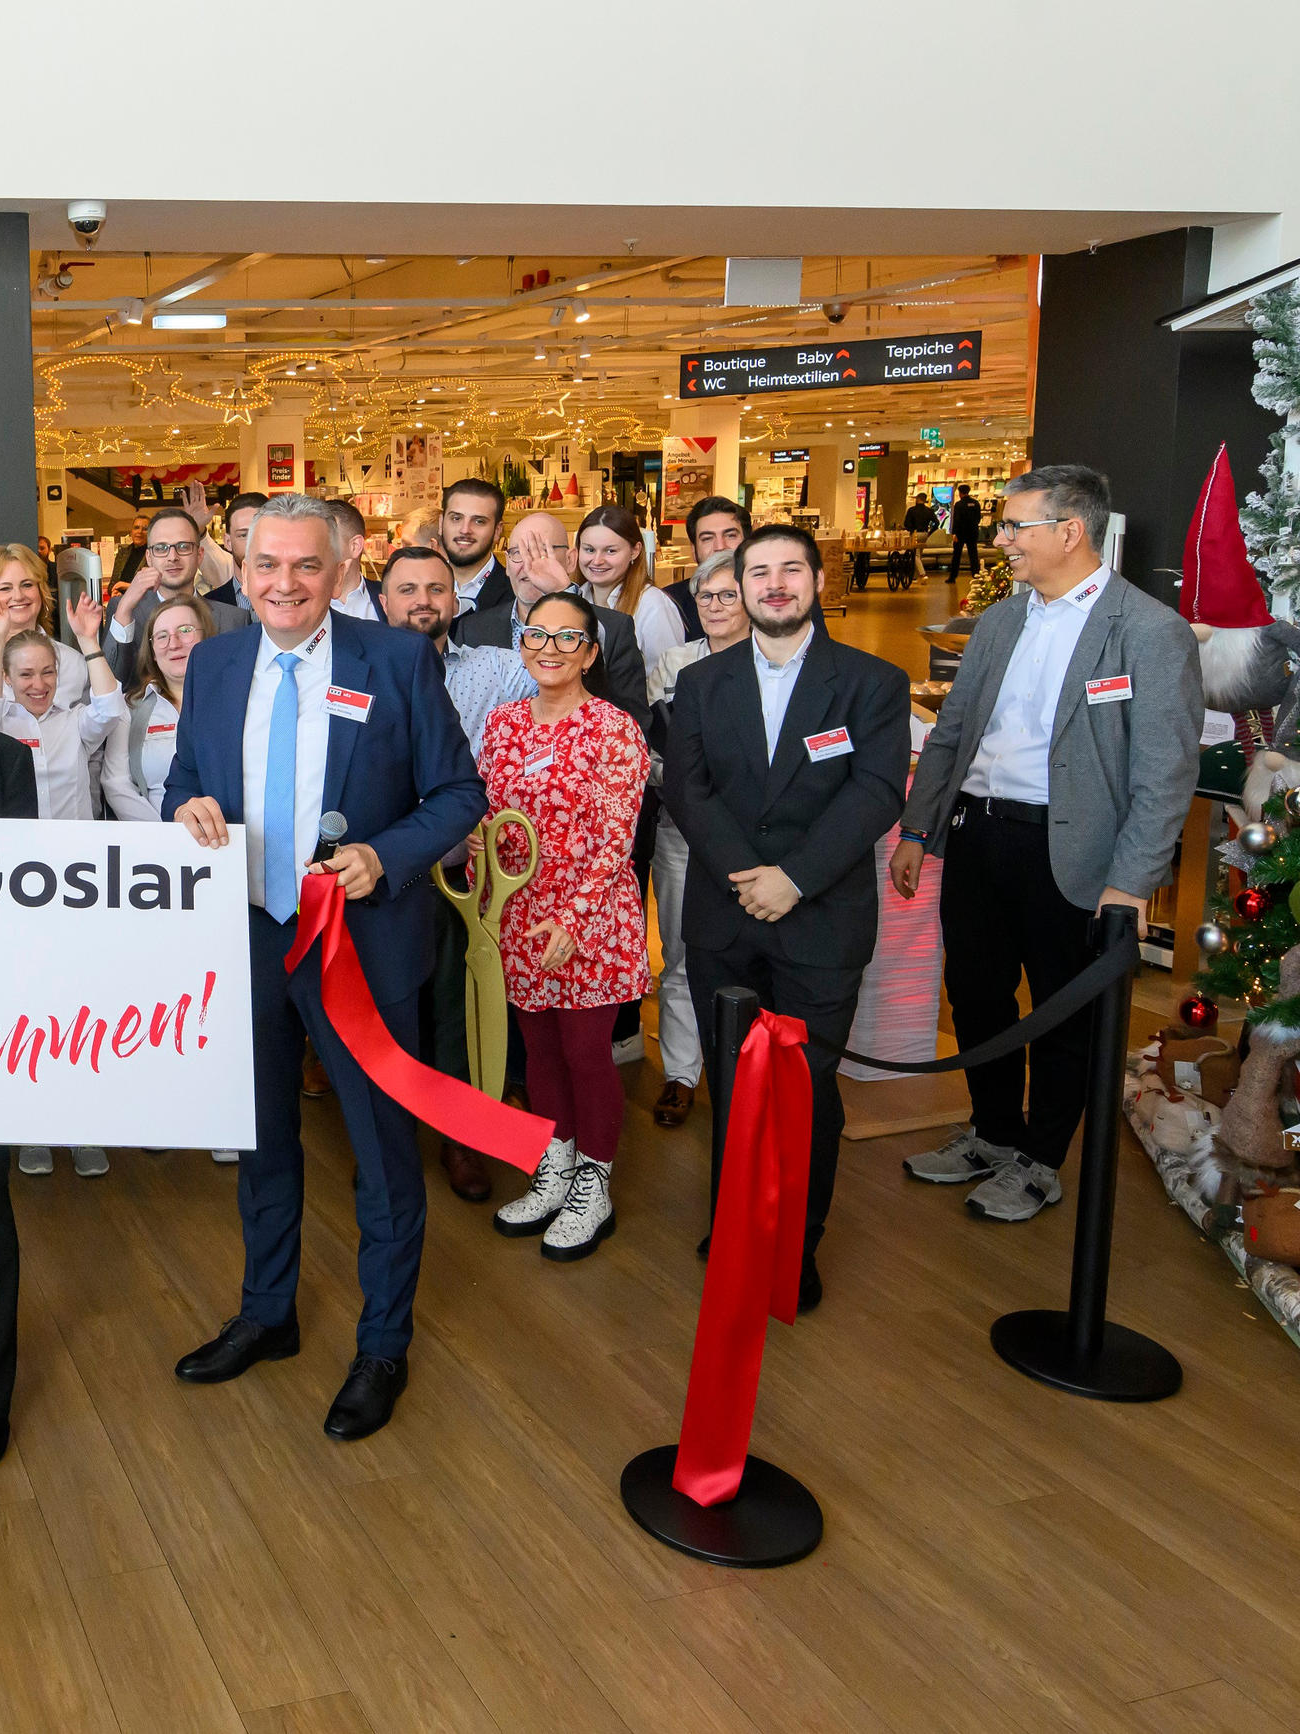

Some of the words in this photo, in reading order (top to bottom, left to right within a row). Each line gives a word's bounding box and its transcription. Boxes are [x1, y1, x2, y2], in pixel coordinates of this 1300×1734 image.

[703, 356, 766, 371] Boutique
[797, 351, 834, 366] Baby
[885, 341, 954, 359] Teppiche
[703, 377, 726, 391] WC
[748, 369, 839, 387] Heimtextilien
[884, 362, 953, 378] Leuchten
